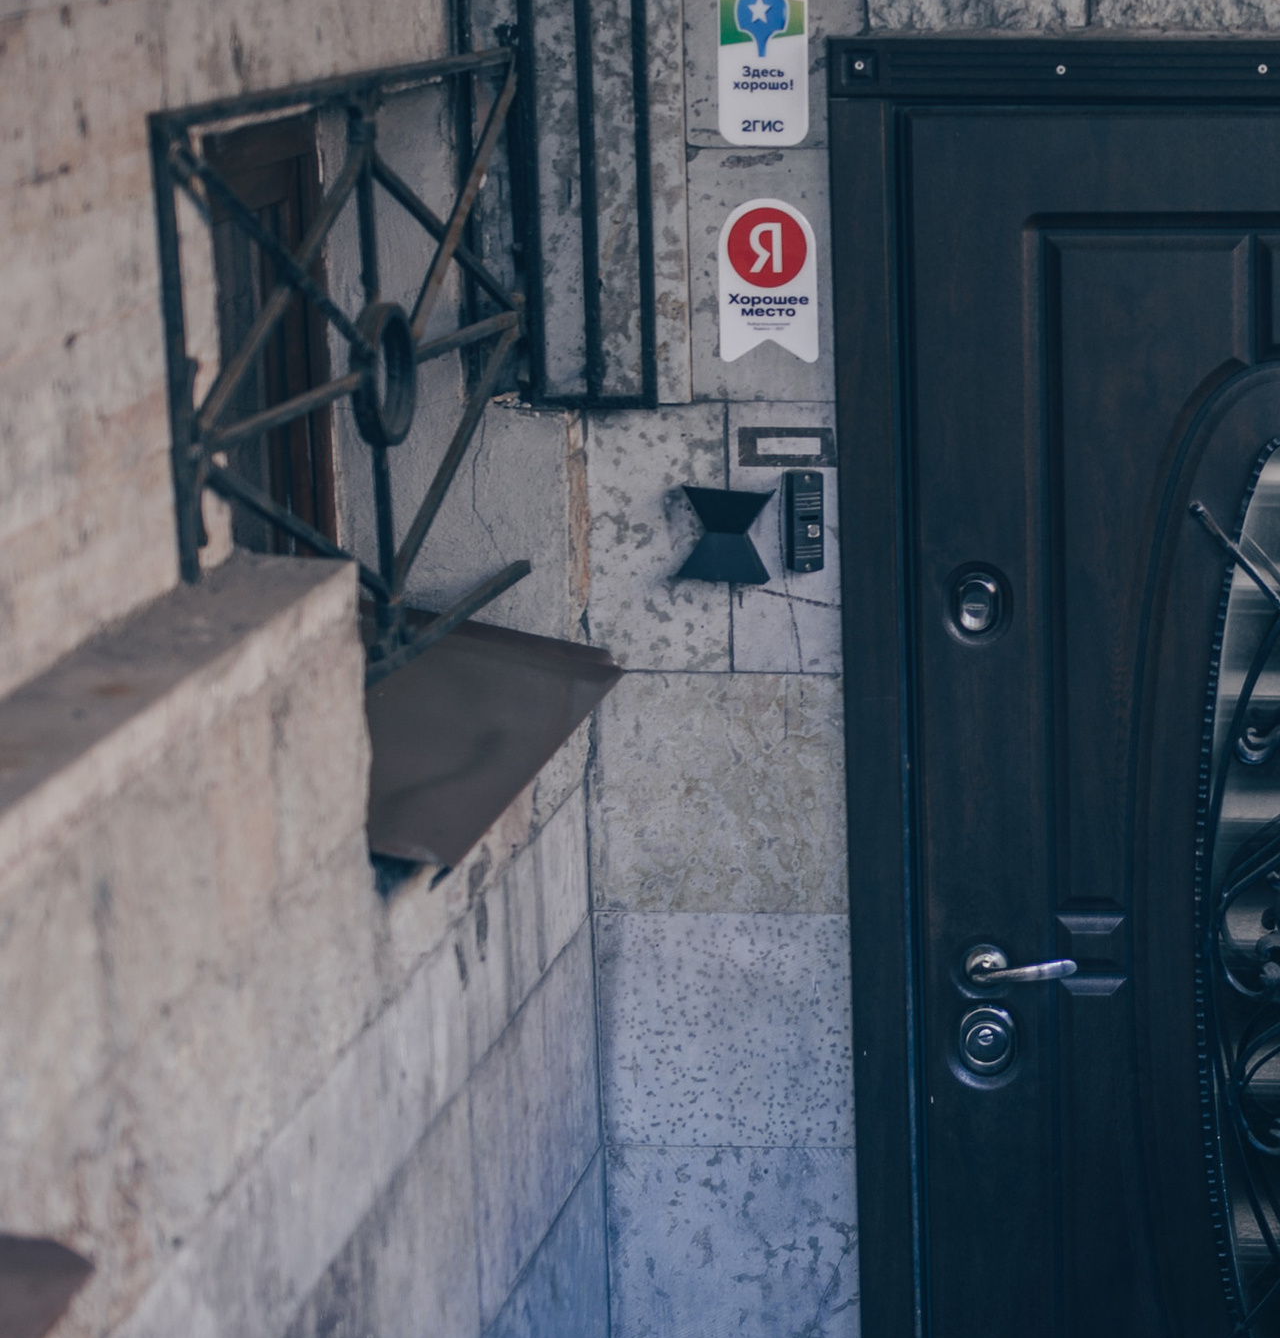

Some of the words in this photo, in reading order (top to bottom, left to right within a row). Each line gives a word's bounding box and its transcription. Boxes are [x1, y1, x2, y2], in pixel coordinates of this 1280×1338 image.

[742, 66, 784, 78] Здесь
[733, 79, 793, 92] хорошо!
[741, 120, 784, 132] 2ГИС
[749, 222, 783, 273] Я
[728, 293, 809, 307] Хорошее
[741, 308, 796, 317] место
